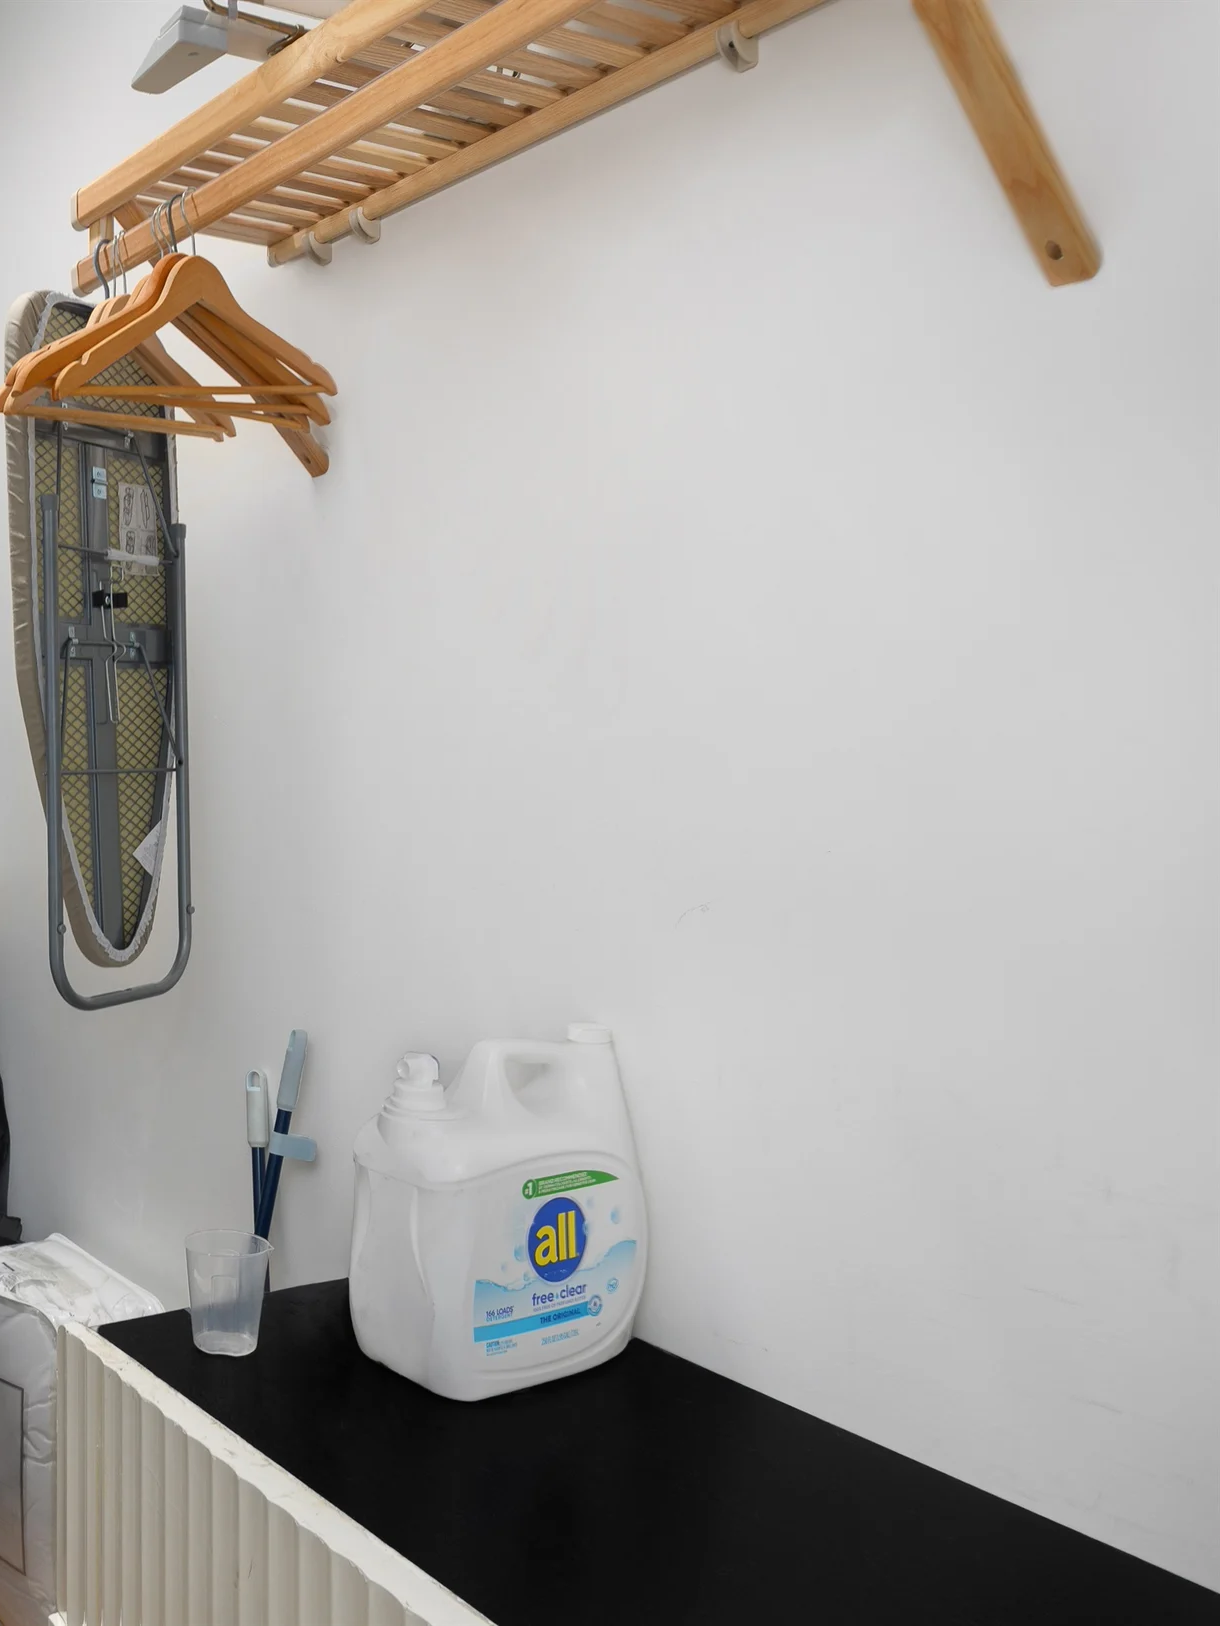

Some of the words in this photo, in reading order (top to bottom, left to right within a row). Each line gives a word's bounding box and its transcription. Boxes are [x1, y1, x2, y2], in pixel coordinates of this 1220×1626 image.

[535, 1210, 577, 1267] all
[532, 1292, 554, 1306] free
[560, 1284, 587, 1299] clear
[540, 1315, 551, 1324] THE
[552, 1308, 582, 1321] ORIGINAL
